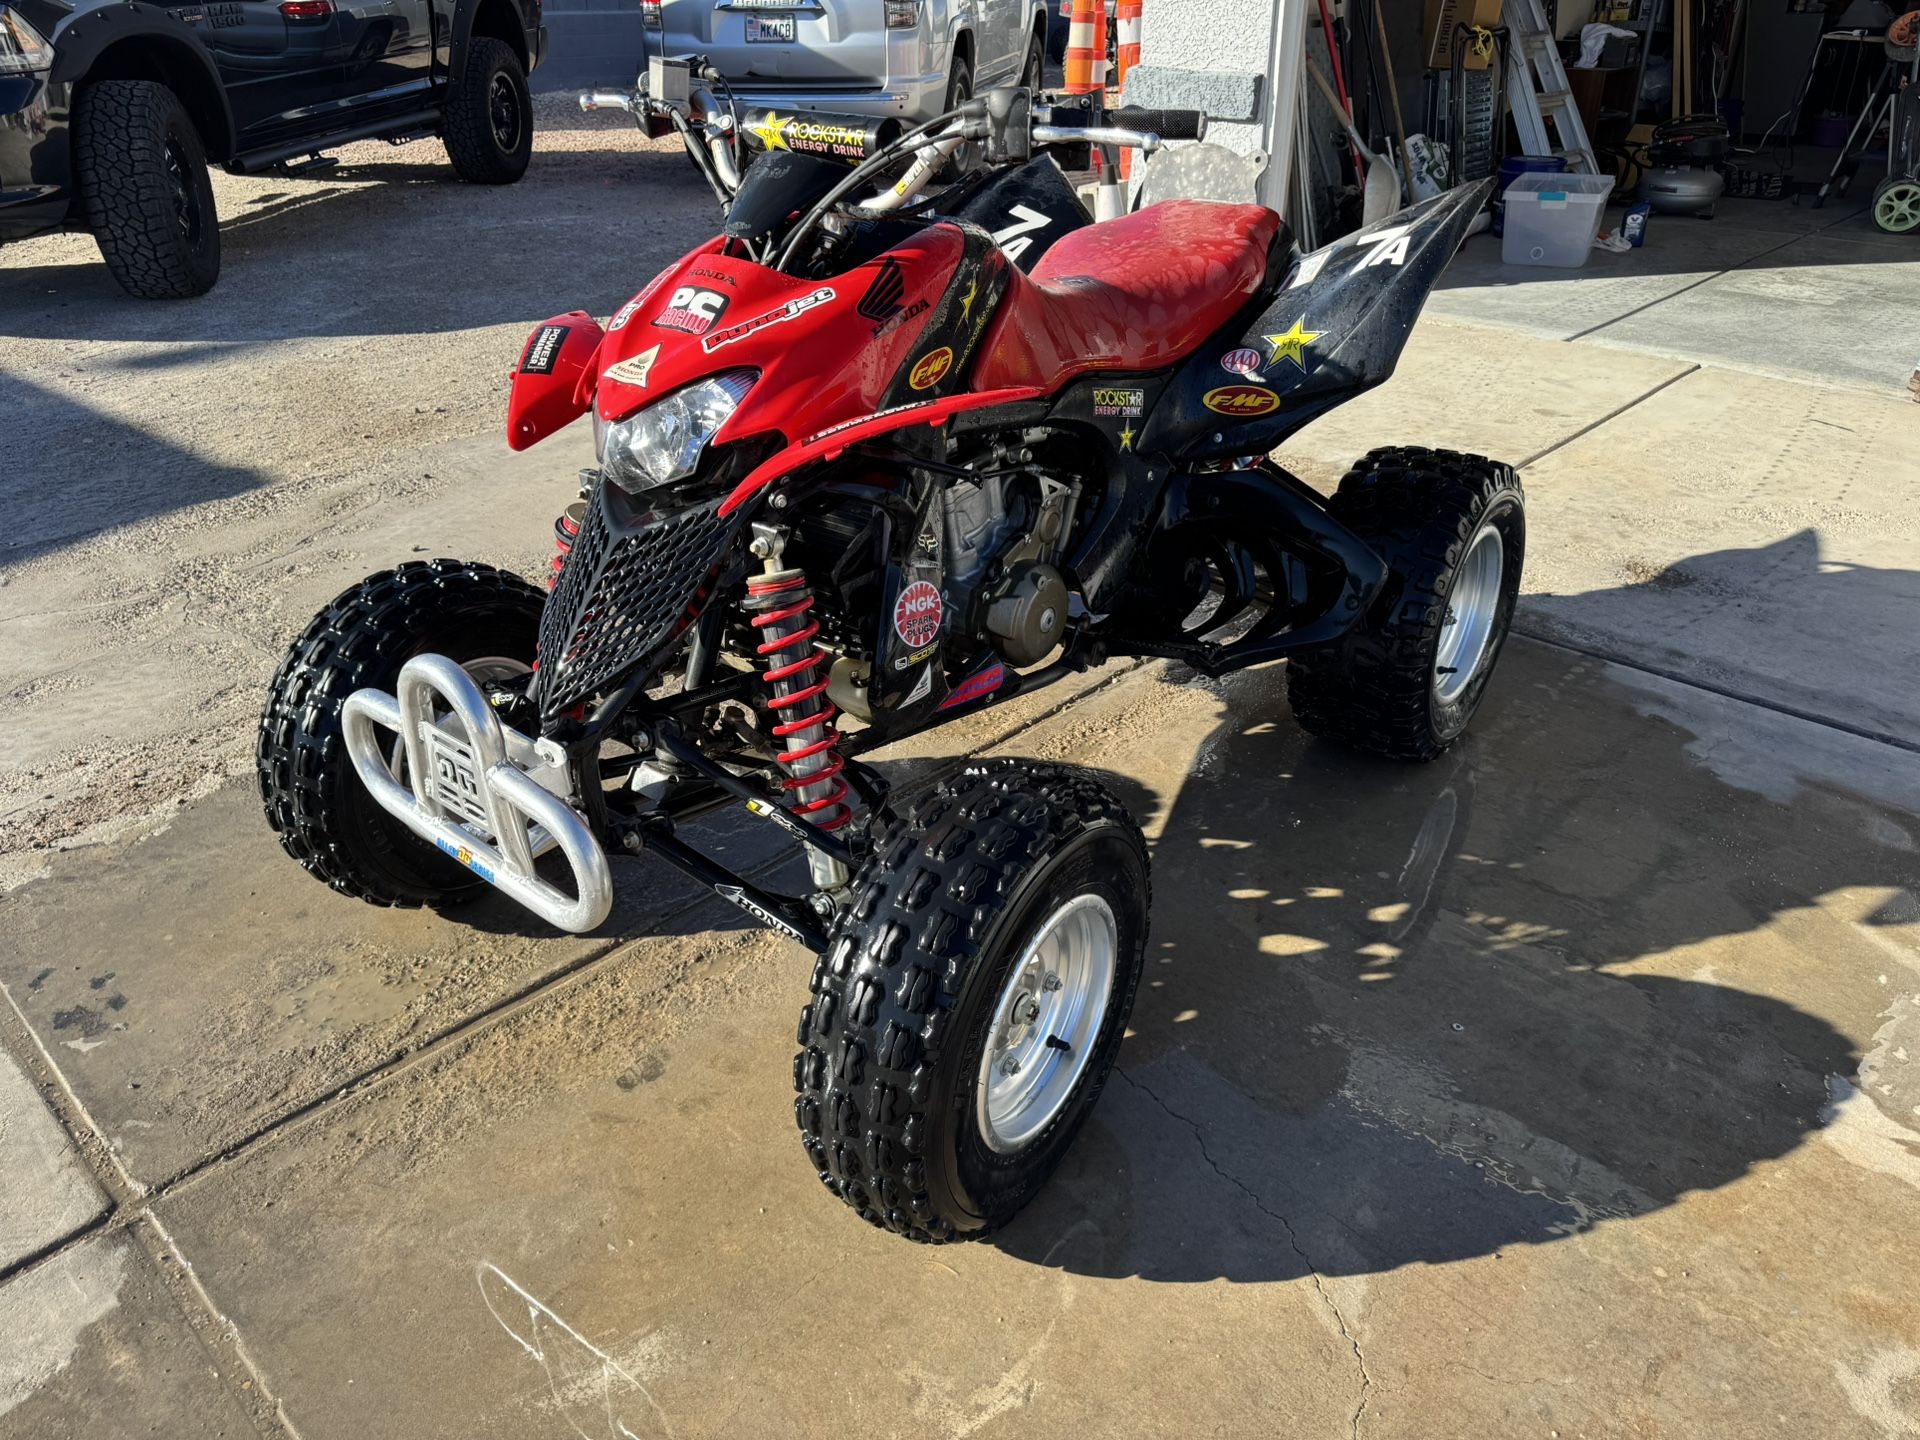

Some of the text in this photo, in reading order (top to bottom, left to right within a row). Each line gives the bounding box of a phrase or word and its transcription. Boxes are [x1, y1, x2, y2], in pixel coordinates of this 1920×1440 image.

[789, 139, 865, 157] ENERGY DRINK
[688, 268, 738, 288] HONDA
[670, 287, 724, 318] PC
[529, 328, 551, 365] COMMANDER
[538, 328, 561, 366] POWER
[629, 362, 645, 370] PRO
[913, 354, 950, 382] FMF
[1209, 393, 1273, 407] FMF
[1095, 406, 1141, 416] ENERGY DRINK
[905, 595, 935, 615] NGK
[907, 614, 933, 628] SPARK
[907, 623, 934, 638] PLUGS
[738, 897, 804, 944] HONDA
